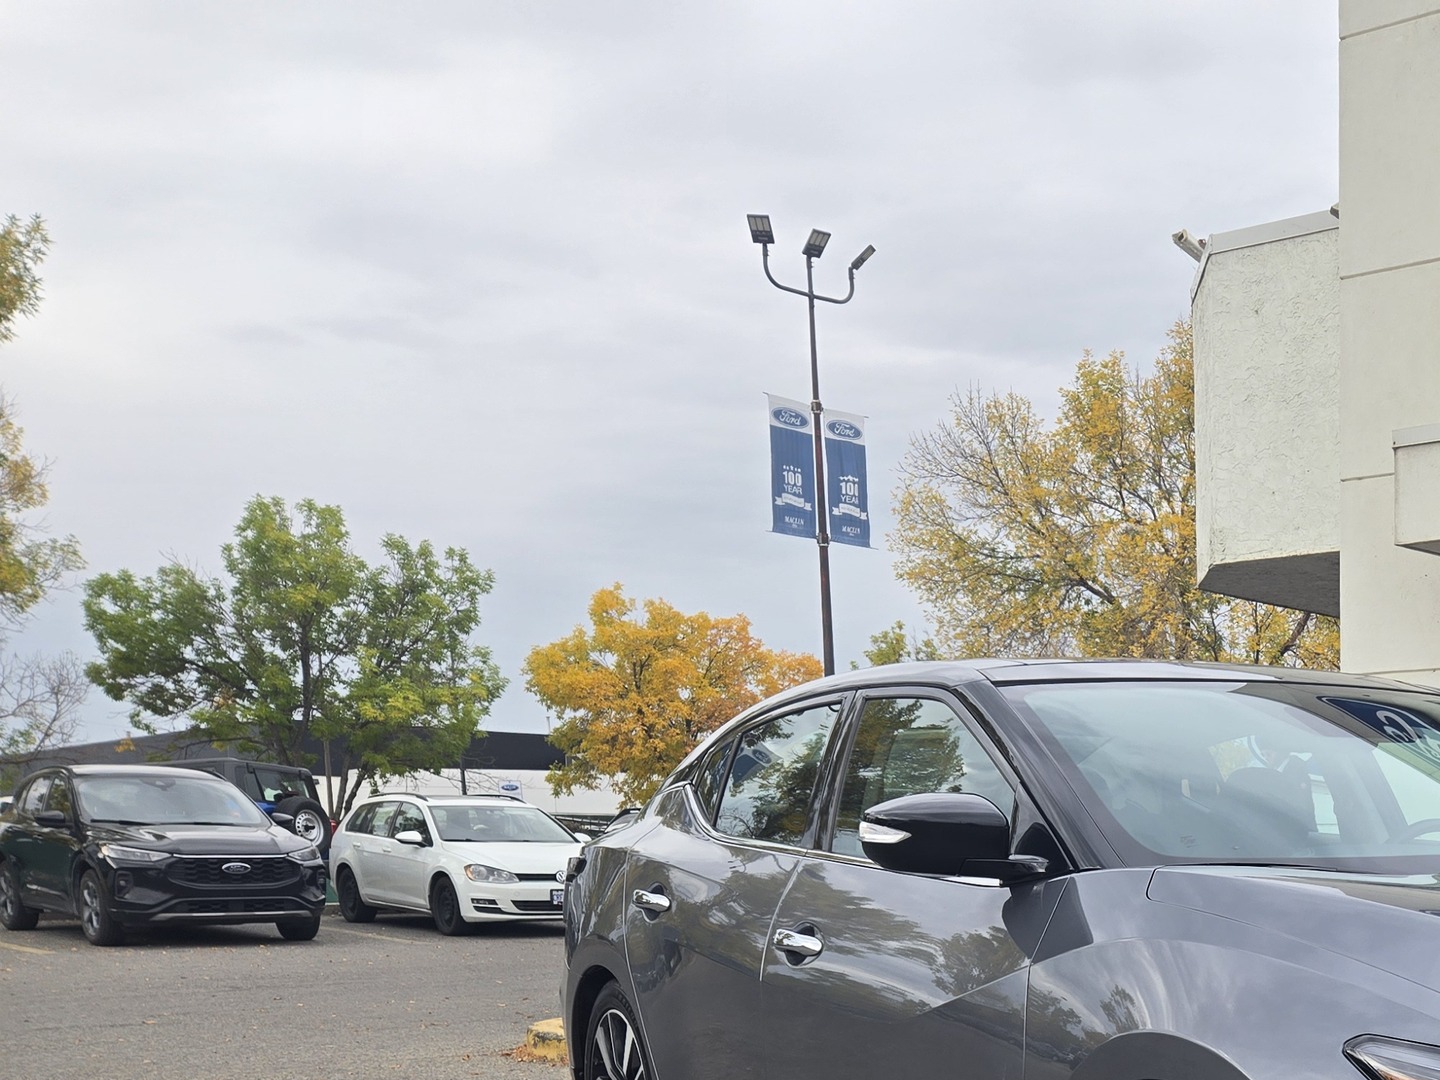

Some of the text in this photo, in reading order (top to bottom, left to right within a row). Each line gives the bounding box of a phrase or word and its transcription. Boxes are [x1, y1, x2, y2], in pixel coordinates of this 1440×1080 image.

[779, 409, 801, 425] Ford
[834, 422, 855, 436] Ford
[782, 471, 802, 486] 100
[784, 484, 803, 495] YEAR
